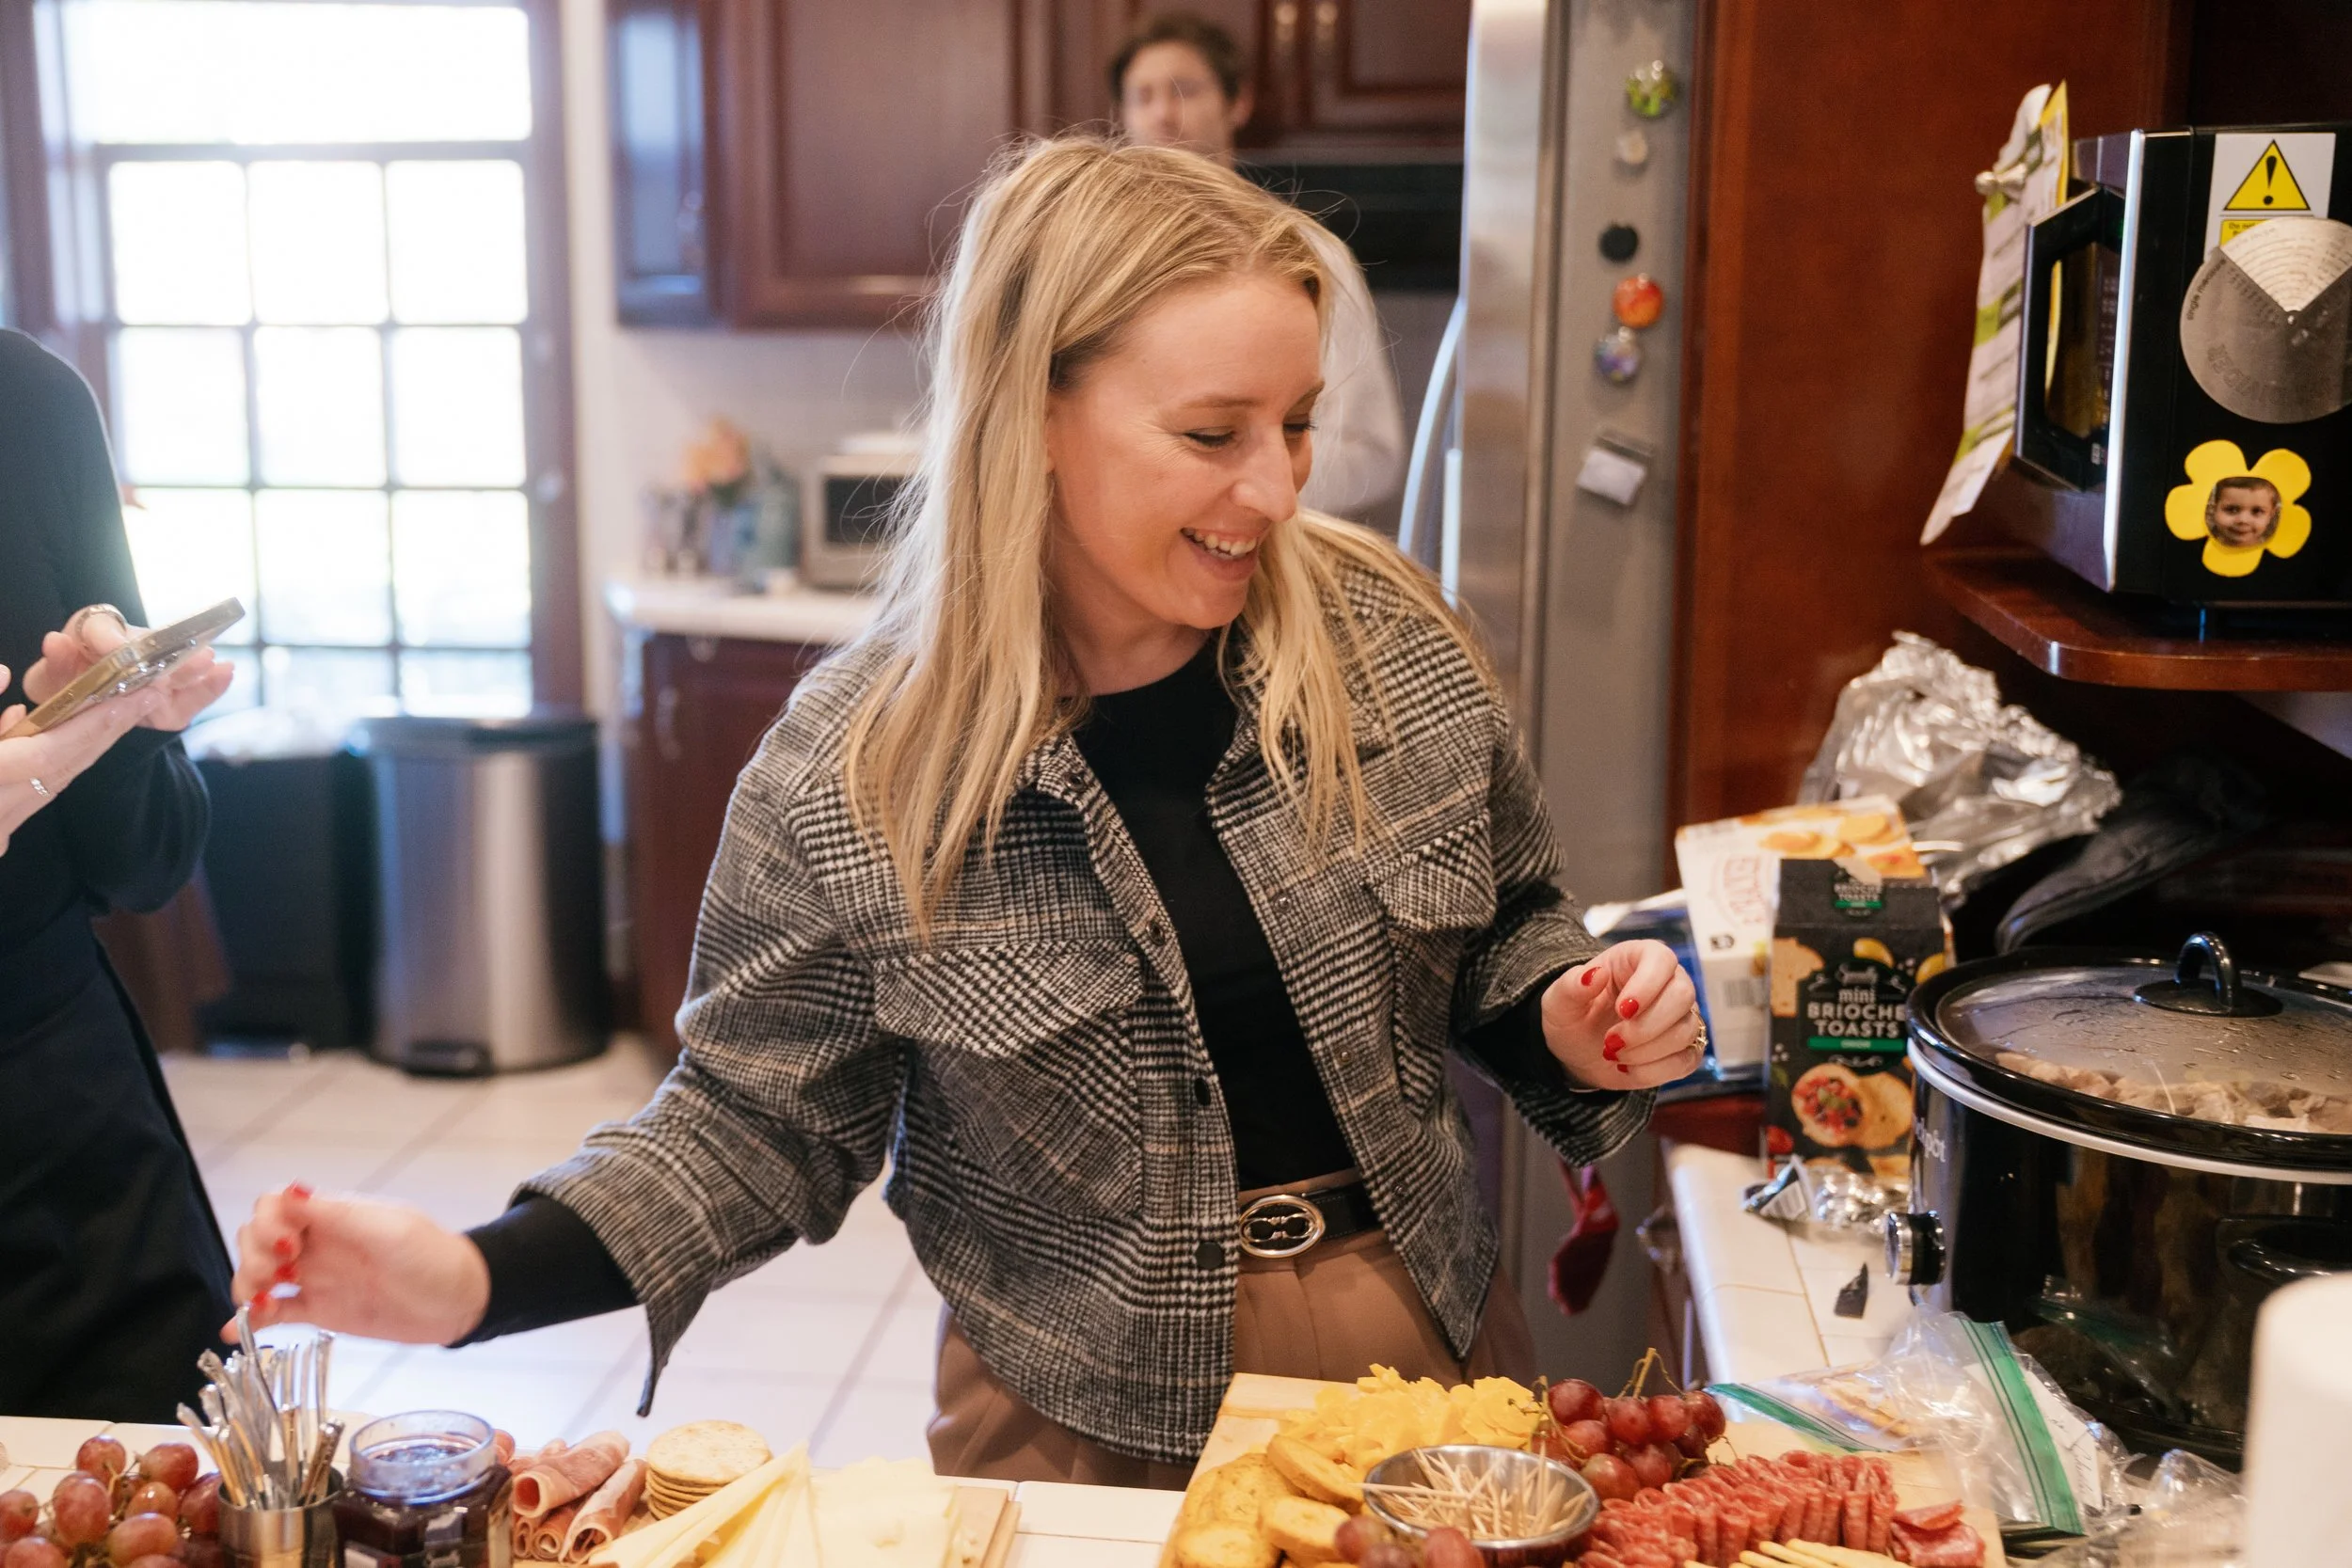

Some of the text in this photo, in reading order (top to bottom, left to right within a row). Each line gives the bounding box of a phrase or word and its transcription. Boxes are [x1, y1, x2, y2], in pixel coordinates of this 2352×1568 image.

[1838, 986, 1876, 1004] mini
[1807, 1002, 1907, 1022] BRIOCHE
[1813, 1018, 1899, 1038] TOASTS
